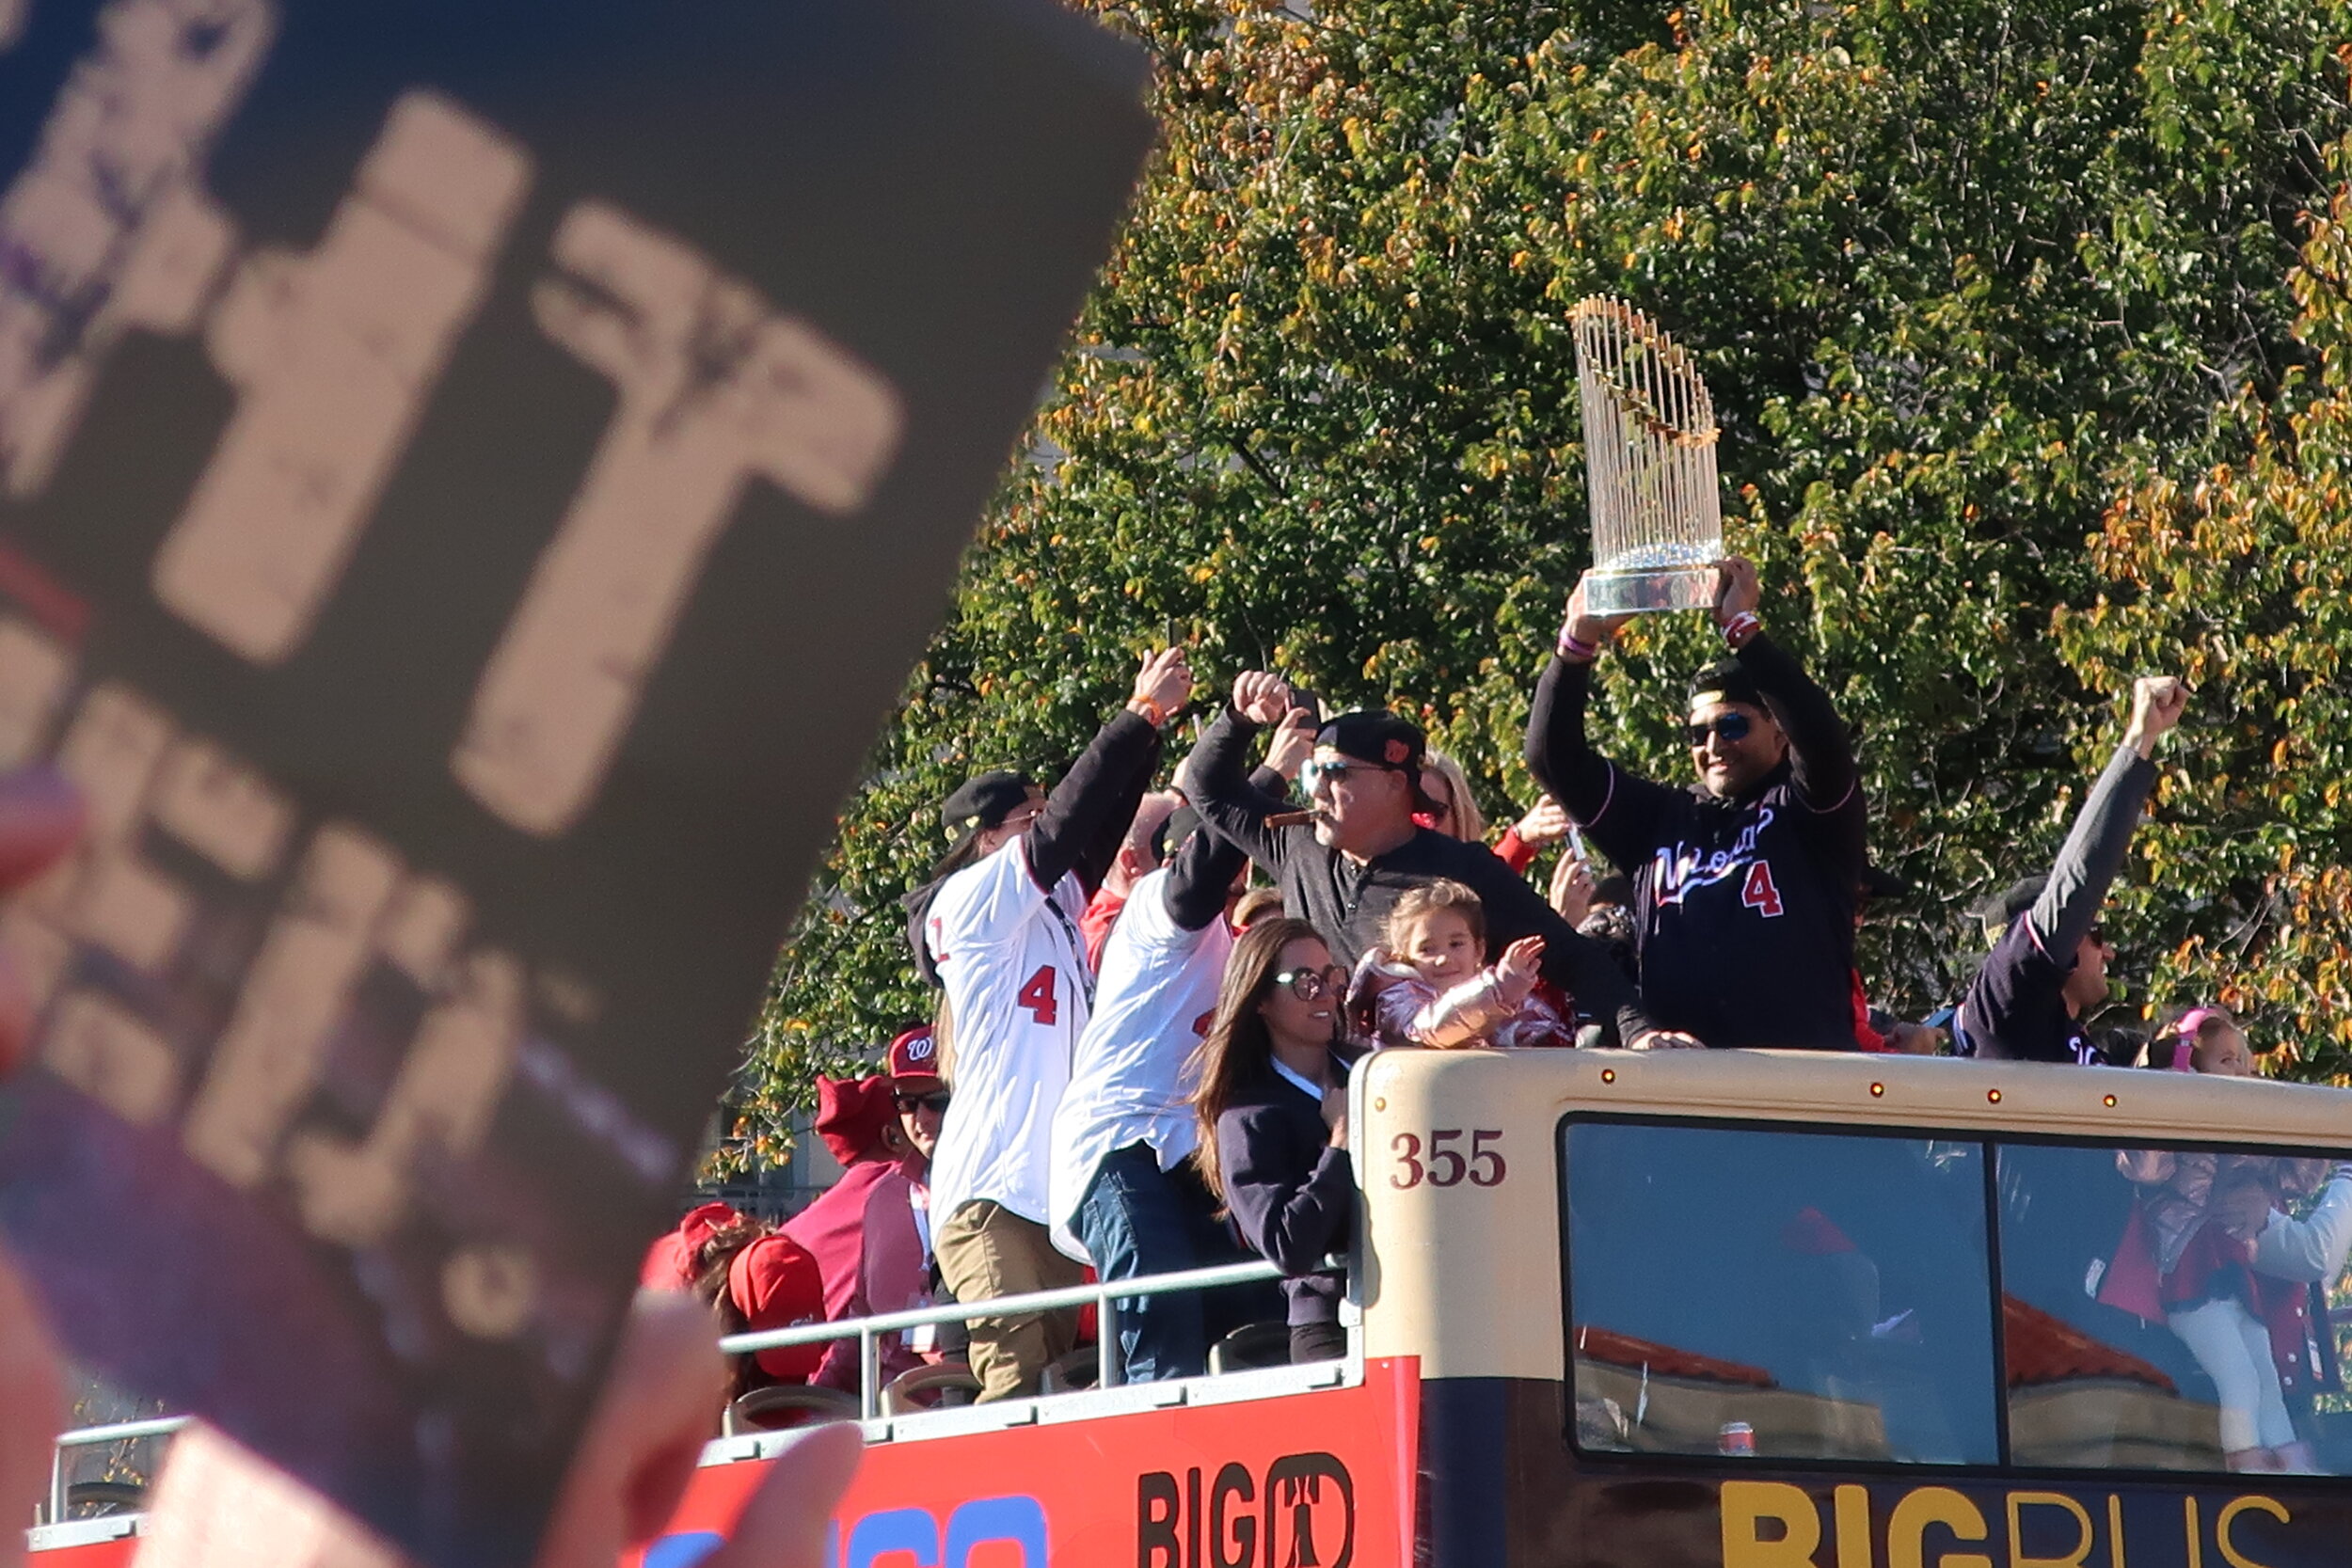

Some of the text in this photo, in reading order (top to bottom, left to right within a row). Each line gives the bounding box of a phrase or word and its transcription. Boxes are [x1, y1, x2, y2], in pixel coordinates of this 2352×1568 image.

[1742, 860, 1785, 918] 4
[1017, 963, 1057, 1027] 4
[907, 1036, 933, 1062] W
[1389, 1129, 1507, 1190] 355
